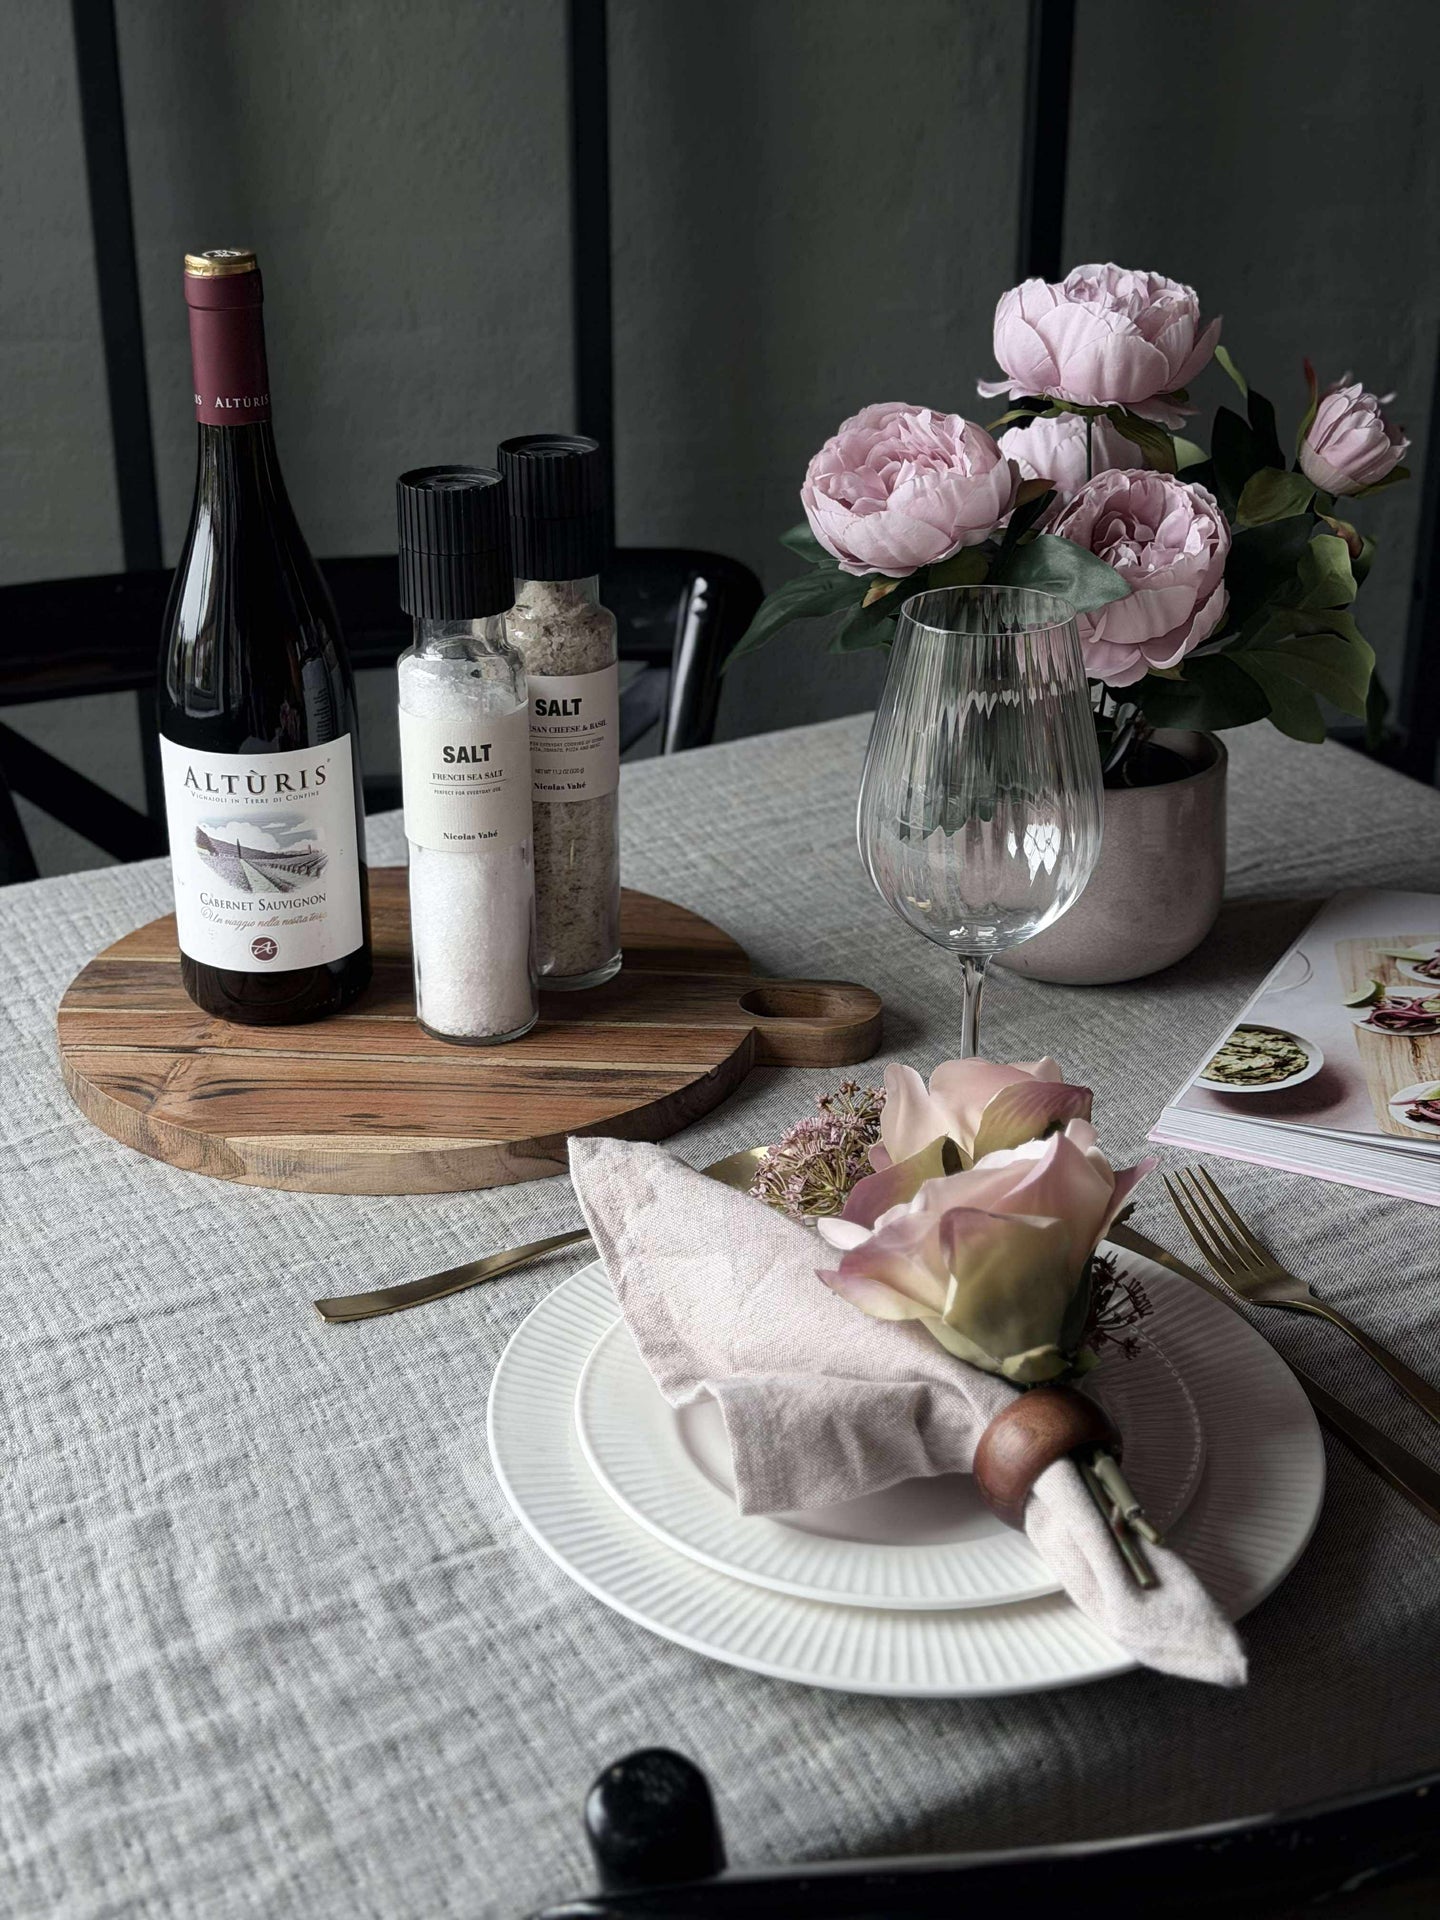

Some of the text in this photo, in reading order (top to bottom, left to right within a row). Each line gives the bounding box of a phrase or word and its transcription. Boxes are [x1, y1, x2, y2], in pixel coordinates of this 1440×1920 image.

[535, 698, 582, 716] SALT
[548, 725, 580, 733] CHEESE
[589, 719, 607, 730] BASIL
[443, 744, 492, 764] SALT
[184, 765, 327, 795] ALTÙRIS
[432, 772, 465, 781] FRENCH
[484, 769, 504, 779] SALT
[534, 781, 586, 791] Nicolas Vahé
[443, 830, 498, 841] Nicolas Vahé
[199, 892, 327, 912] CABERNET SAUVIGNON
[224, 919, 256, 931] viaggio
[257, 915, 280, 927] nella
